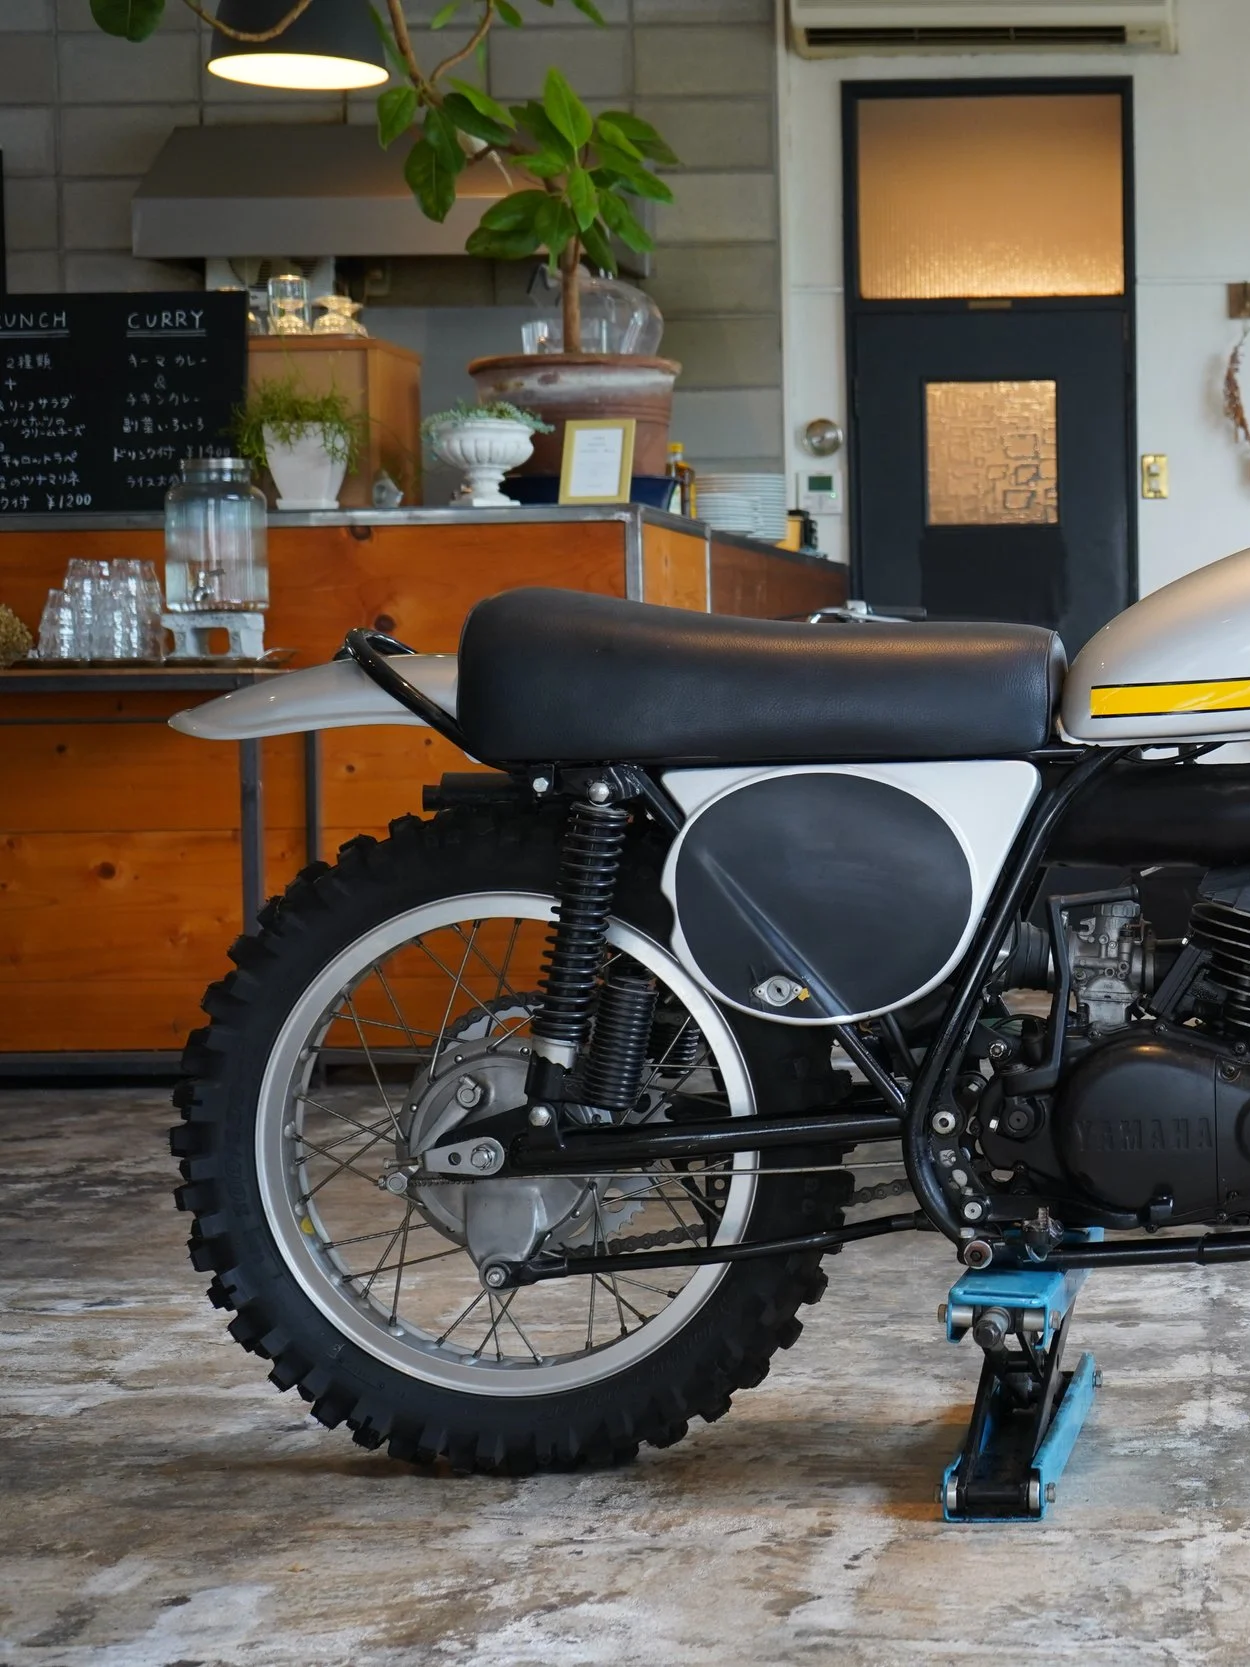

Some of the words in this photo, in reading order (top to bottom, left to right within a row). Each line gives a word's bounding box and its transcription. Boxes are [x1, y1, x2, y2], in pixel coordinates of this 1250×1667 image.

[0, 310, 66, 329] UNCH
[127, 310, 204, 329] CURRY
[1075, 1116, 1213, 1152] YAMAHA
